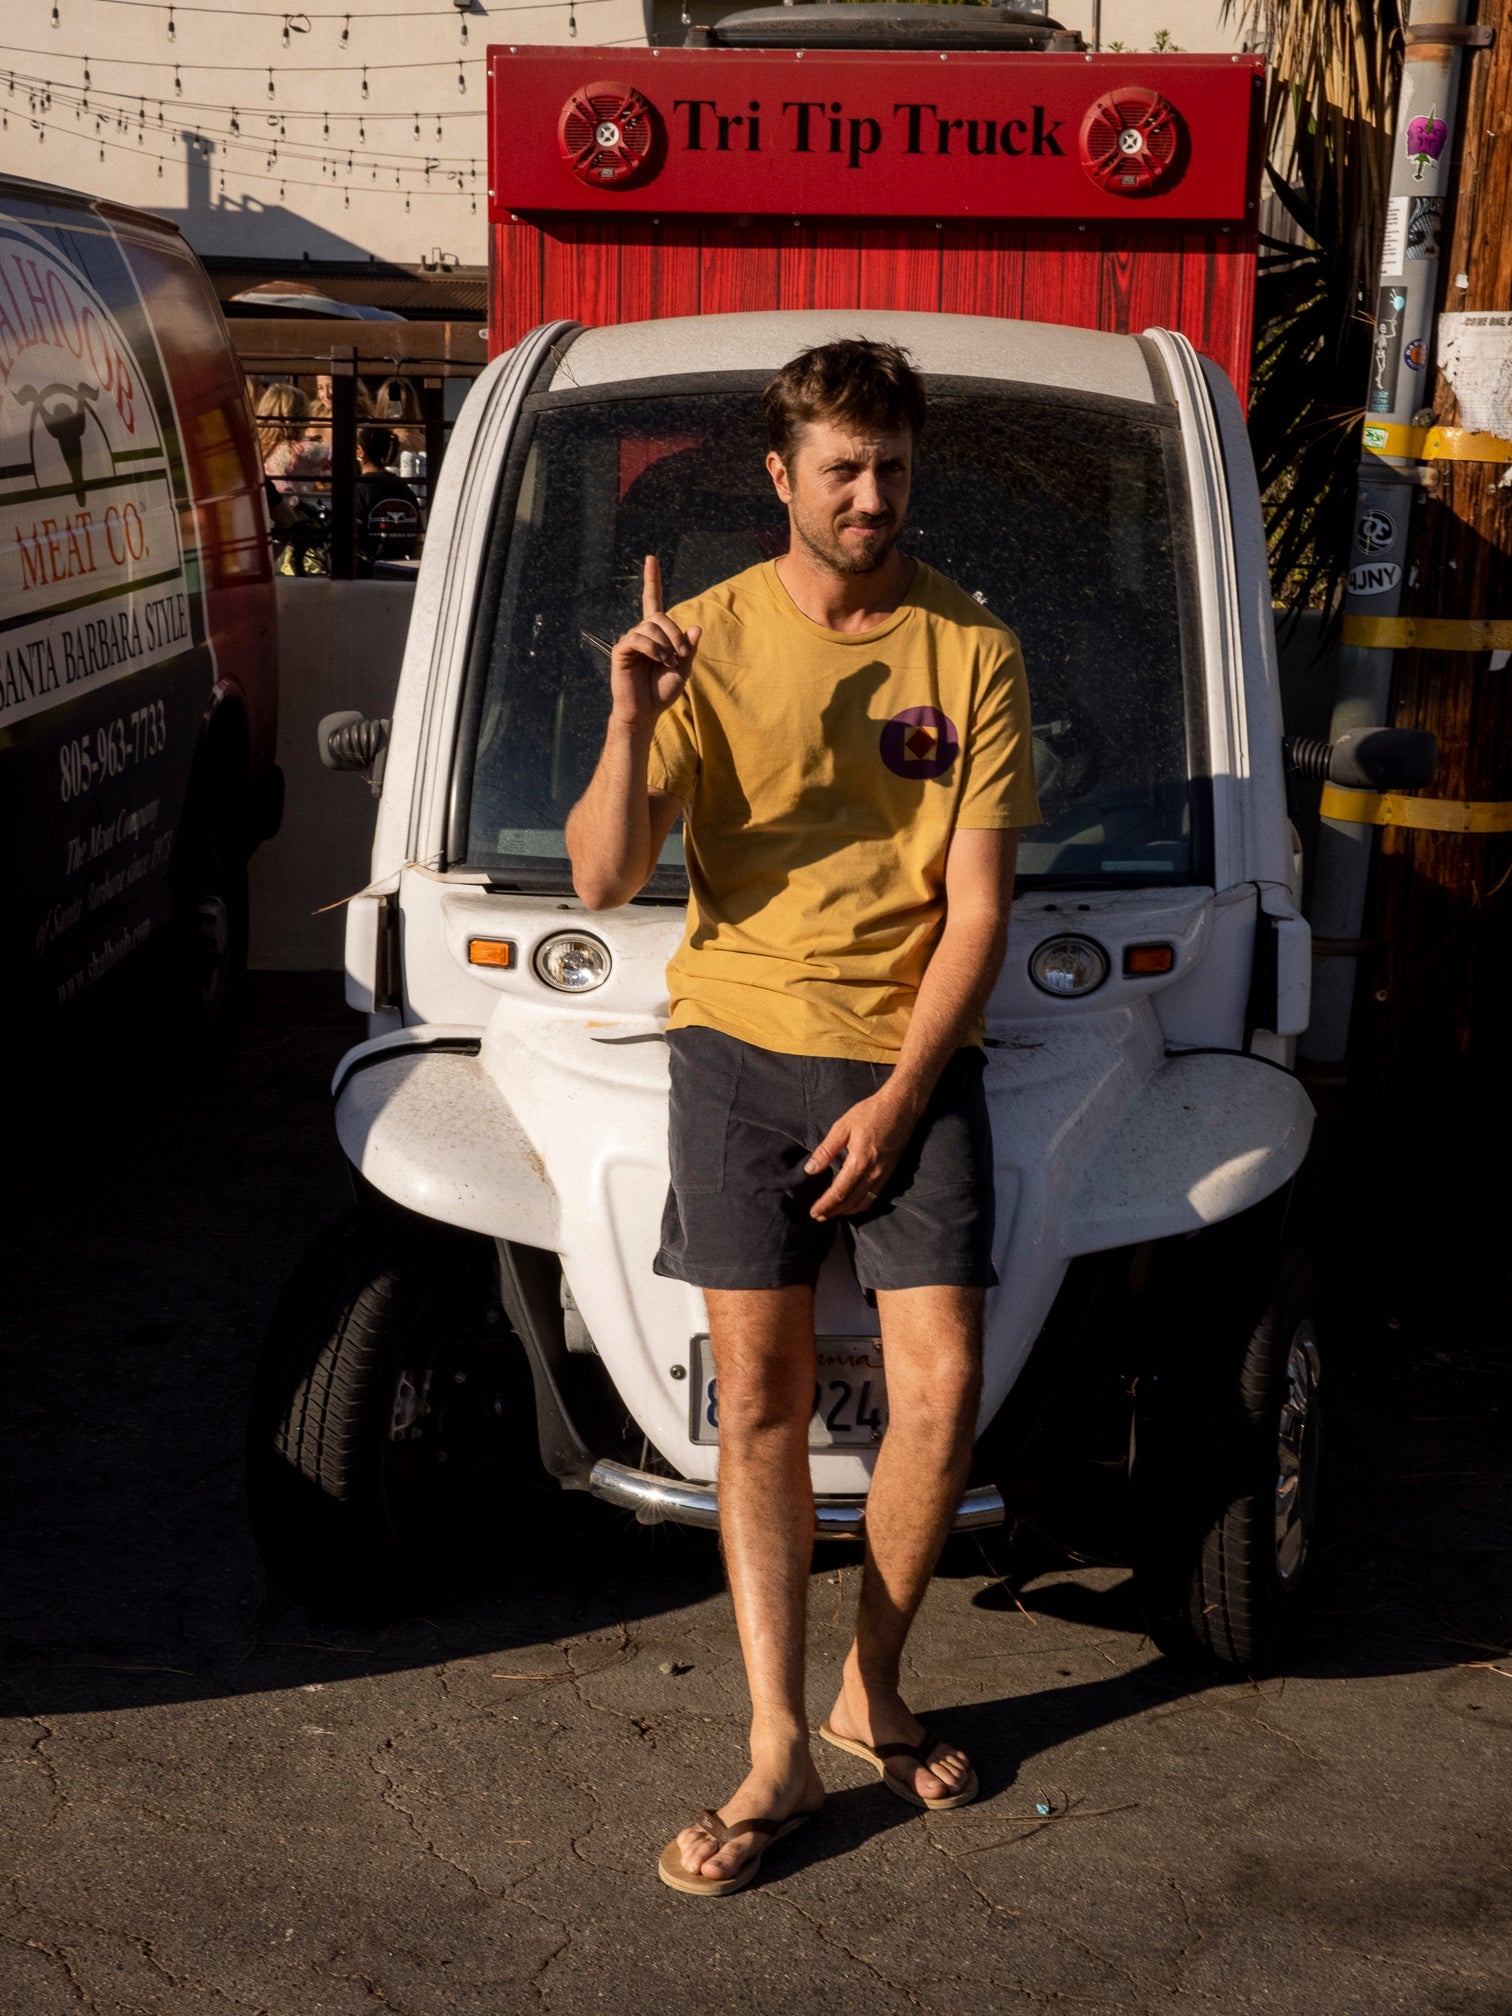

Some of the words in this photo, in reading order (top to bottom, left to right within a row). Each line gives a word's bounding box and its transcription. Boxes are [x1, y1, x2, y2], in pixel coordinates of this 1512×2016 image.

[674, 100, 761, 152] Tri
[783, 101, 881, 169] Tip
[894, 103, 1067, 157] Truck
[0, 254, 135, 434] ALHOOB
[16, 512, 97, 590] MEAT
[104, 502, 150, 566] CO.
[62, 611, 144, 684] BARBARA
[144, 593, 188, 652] STYLE
[60, 698, 167, 804] 805-963-7733
